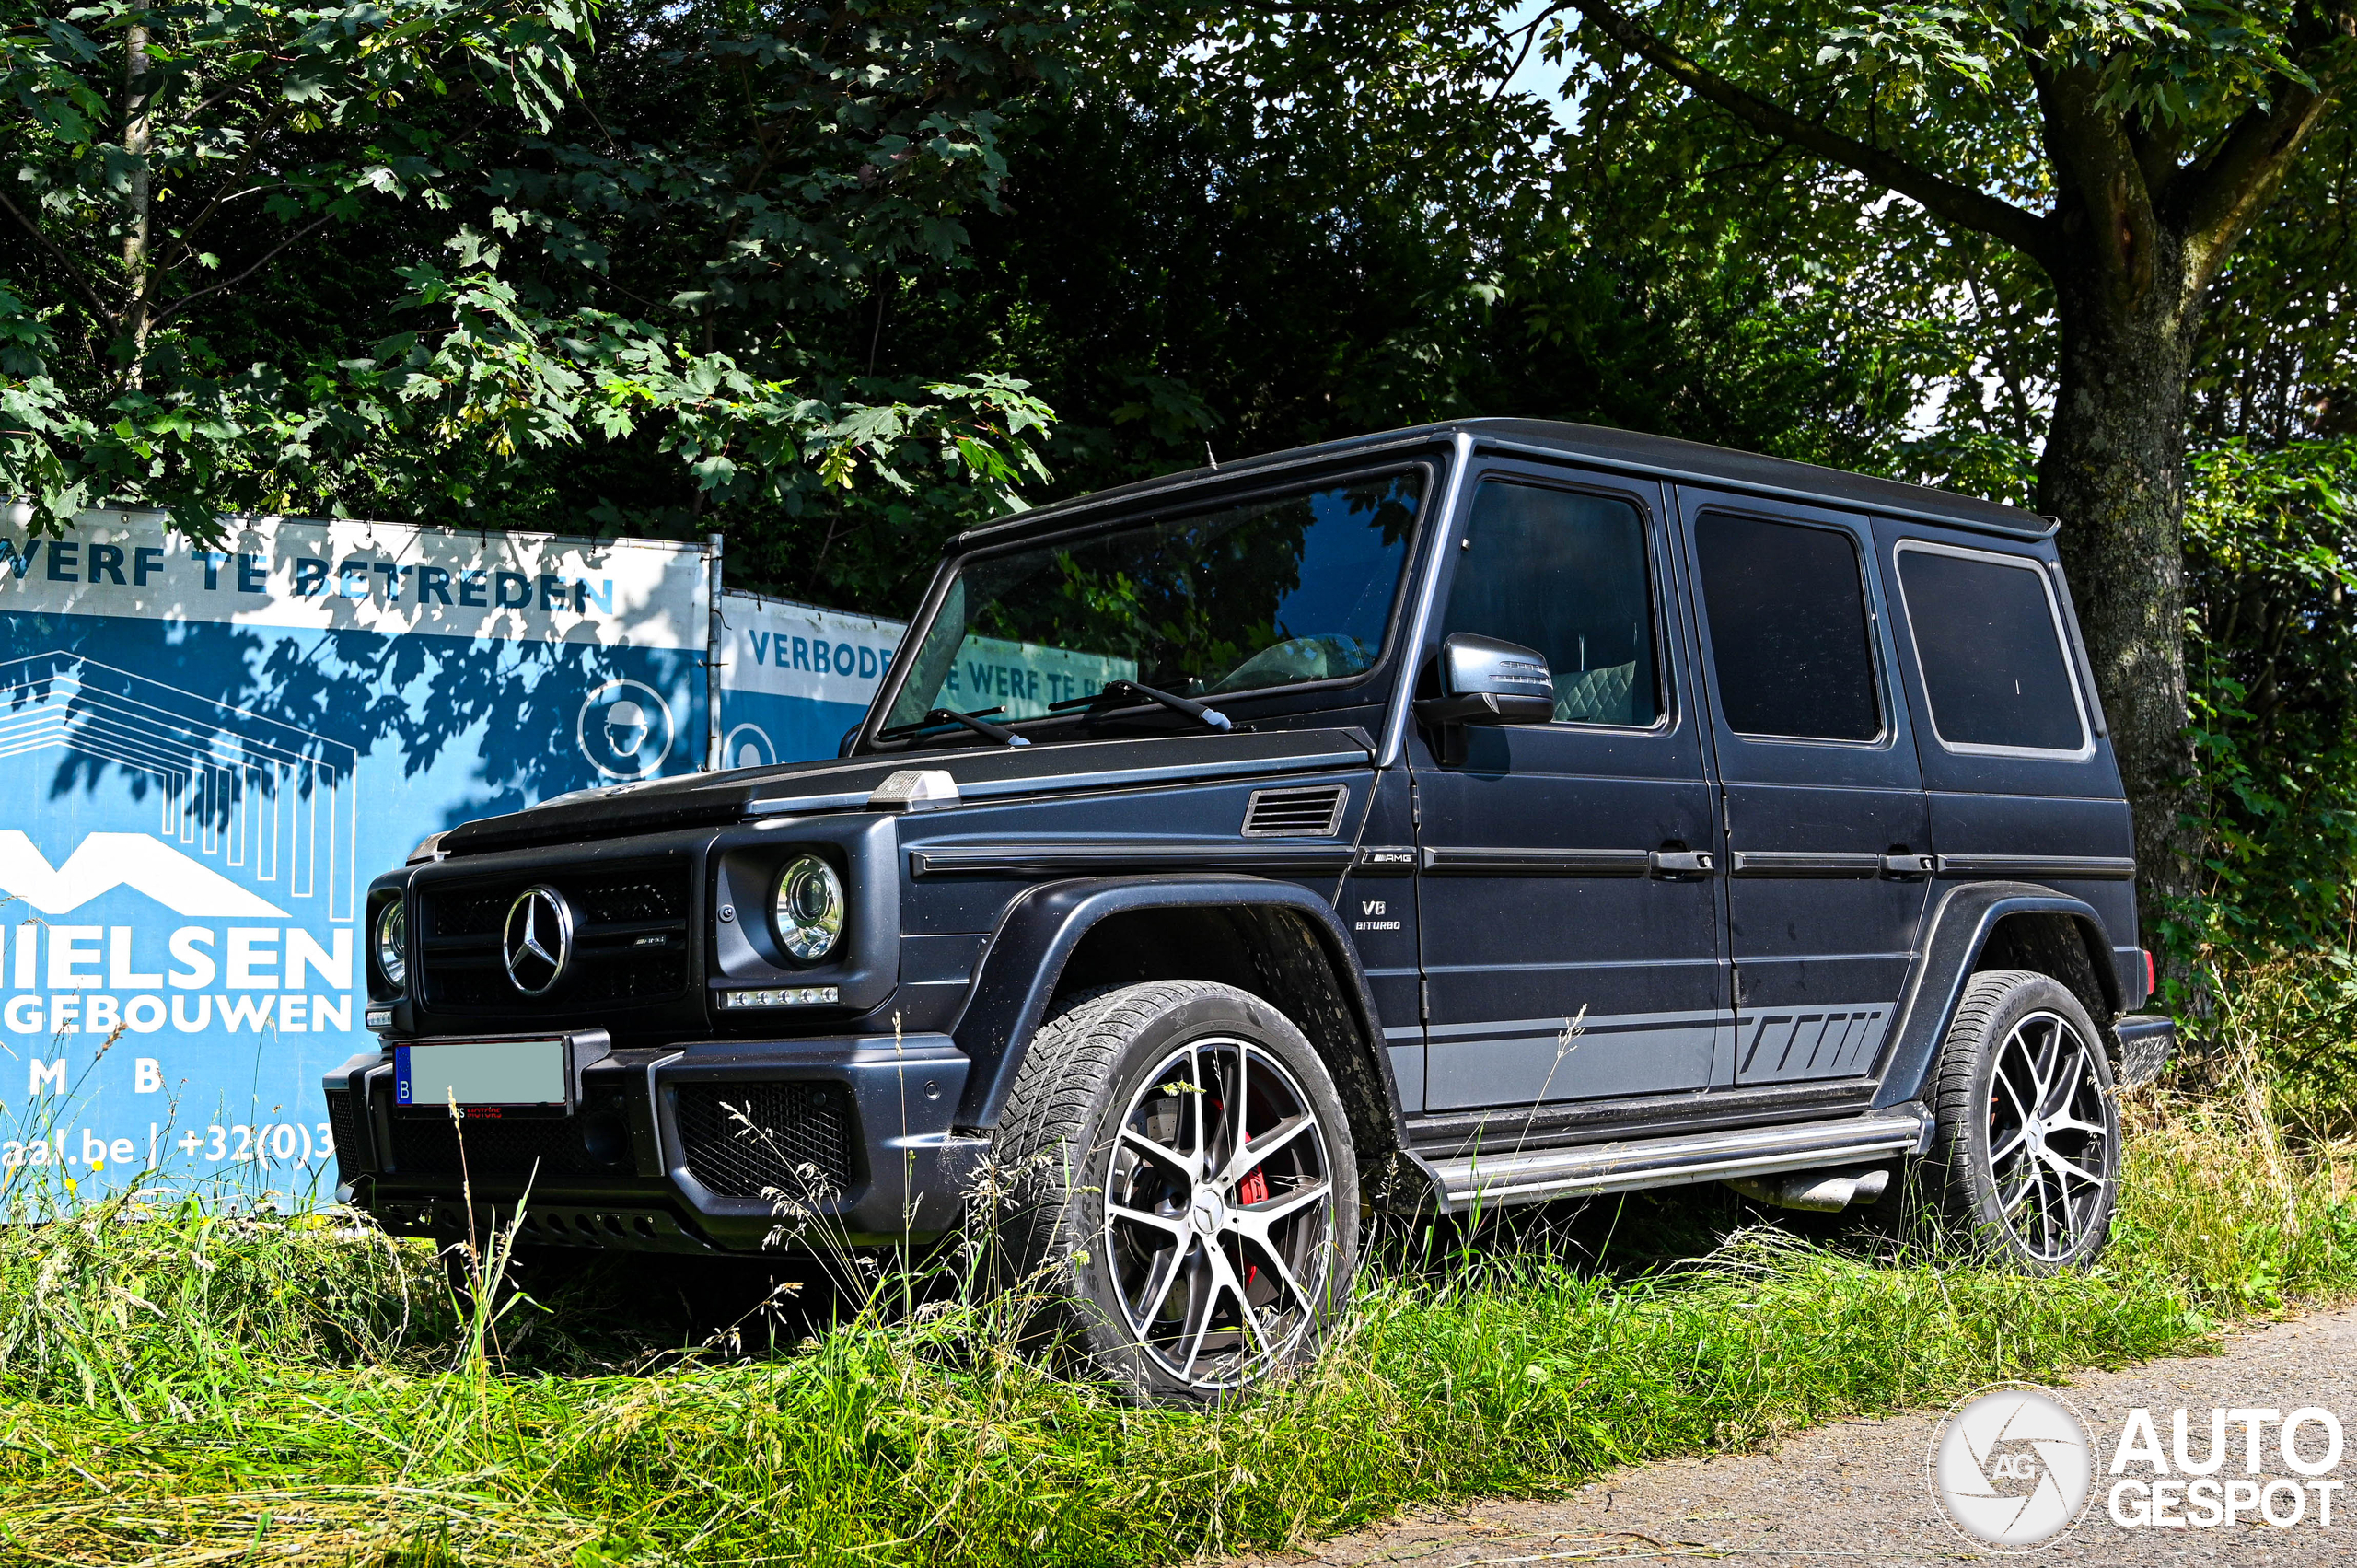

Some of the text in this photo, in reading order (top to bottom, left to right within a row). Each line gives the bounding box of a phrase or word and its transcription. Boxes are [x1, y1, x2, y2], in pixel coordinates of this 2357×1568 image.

[191, 550, 268, 594] TE
[296, 556, 613, 615] BETREDEN
[968, 661, 1039, 700] WERF
[1046, 673, 1075, 703] TE
[1362, 900, 1387, 915] V8
[1355, 921, 1400, 930] BITURBO
[0, 924, 354, 990] IELSEN
[4, 994, 353, 1034] GEBOUWEN
[400, 1080, 410, 1099] B
[467, 1107, 504, 1119] MOTORS
